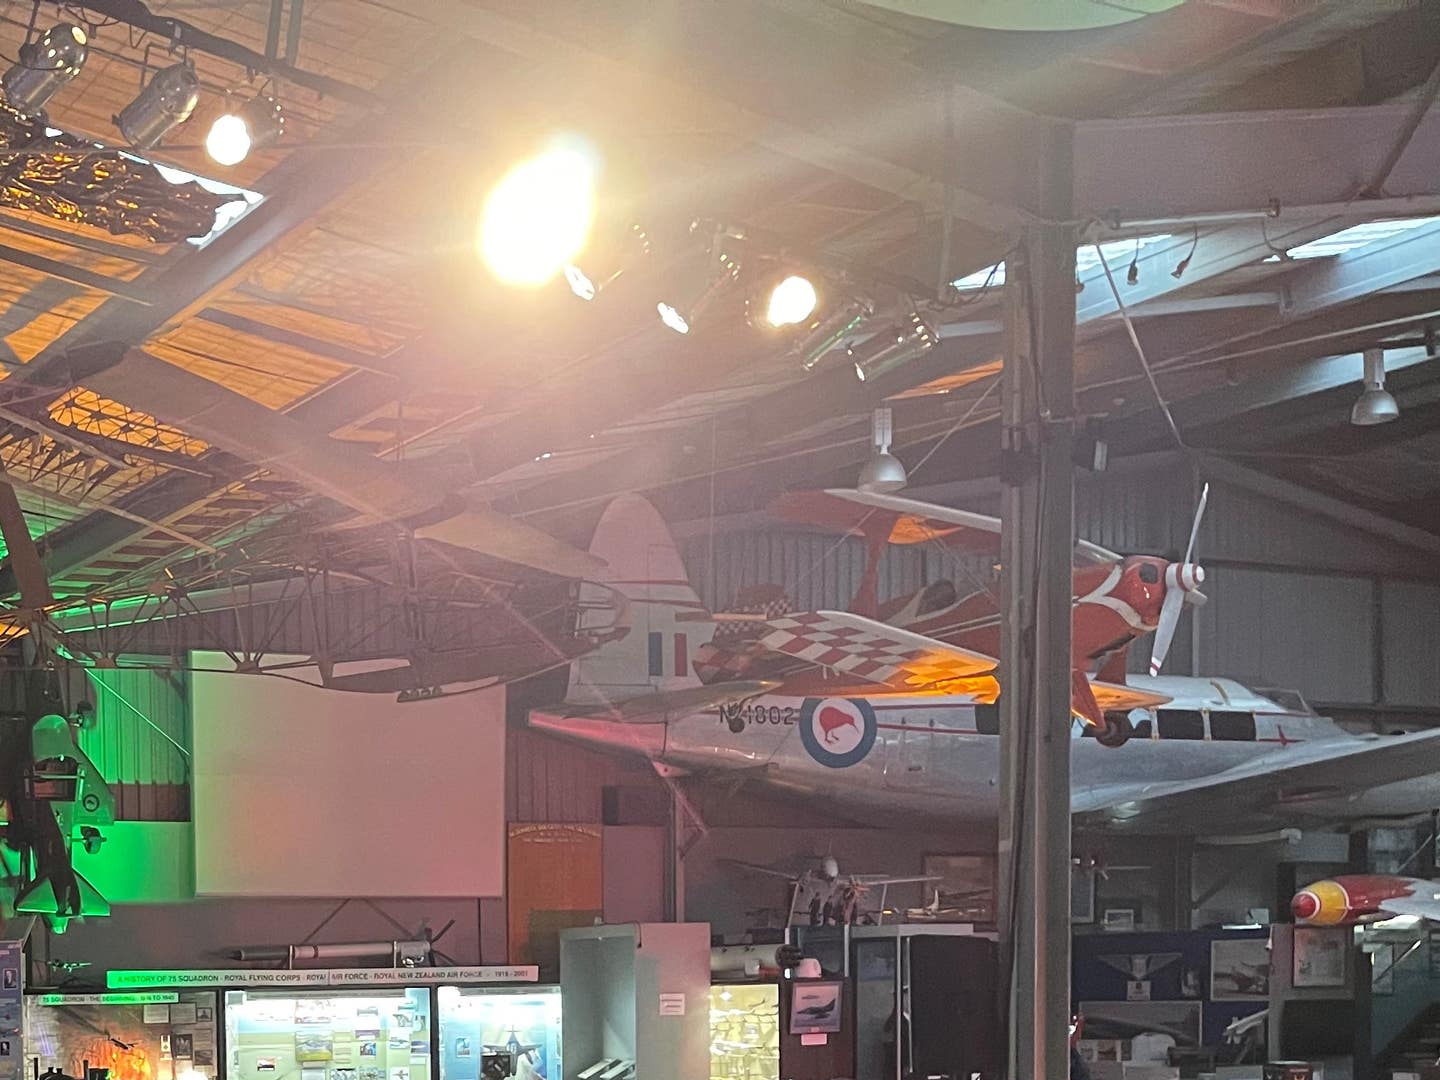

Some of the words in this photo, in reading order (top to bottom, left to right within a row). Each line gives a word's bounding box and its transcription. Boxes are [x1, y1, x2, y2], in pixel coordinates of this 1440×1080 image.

[720, 704, 794, 725] N1802
[124, 975, 155, 983] HISTORY
[178, 974, 219, 982] SQUADRON
[414, 971, 446, 979] ZEALAND
